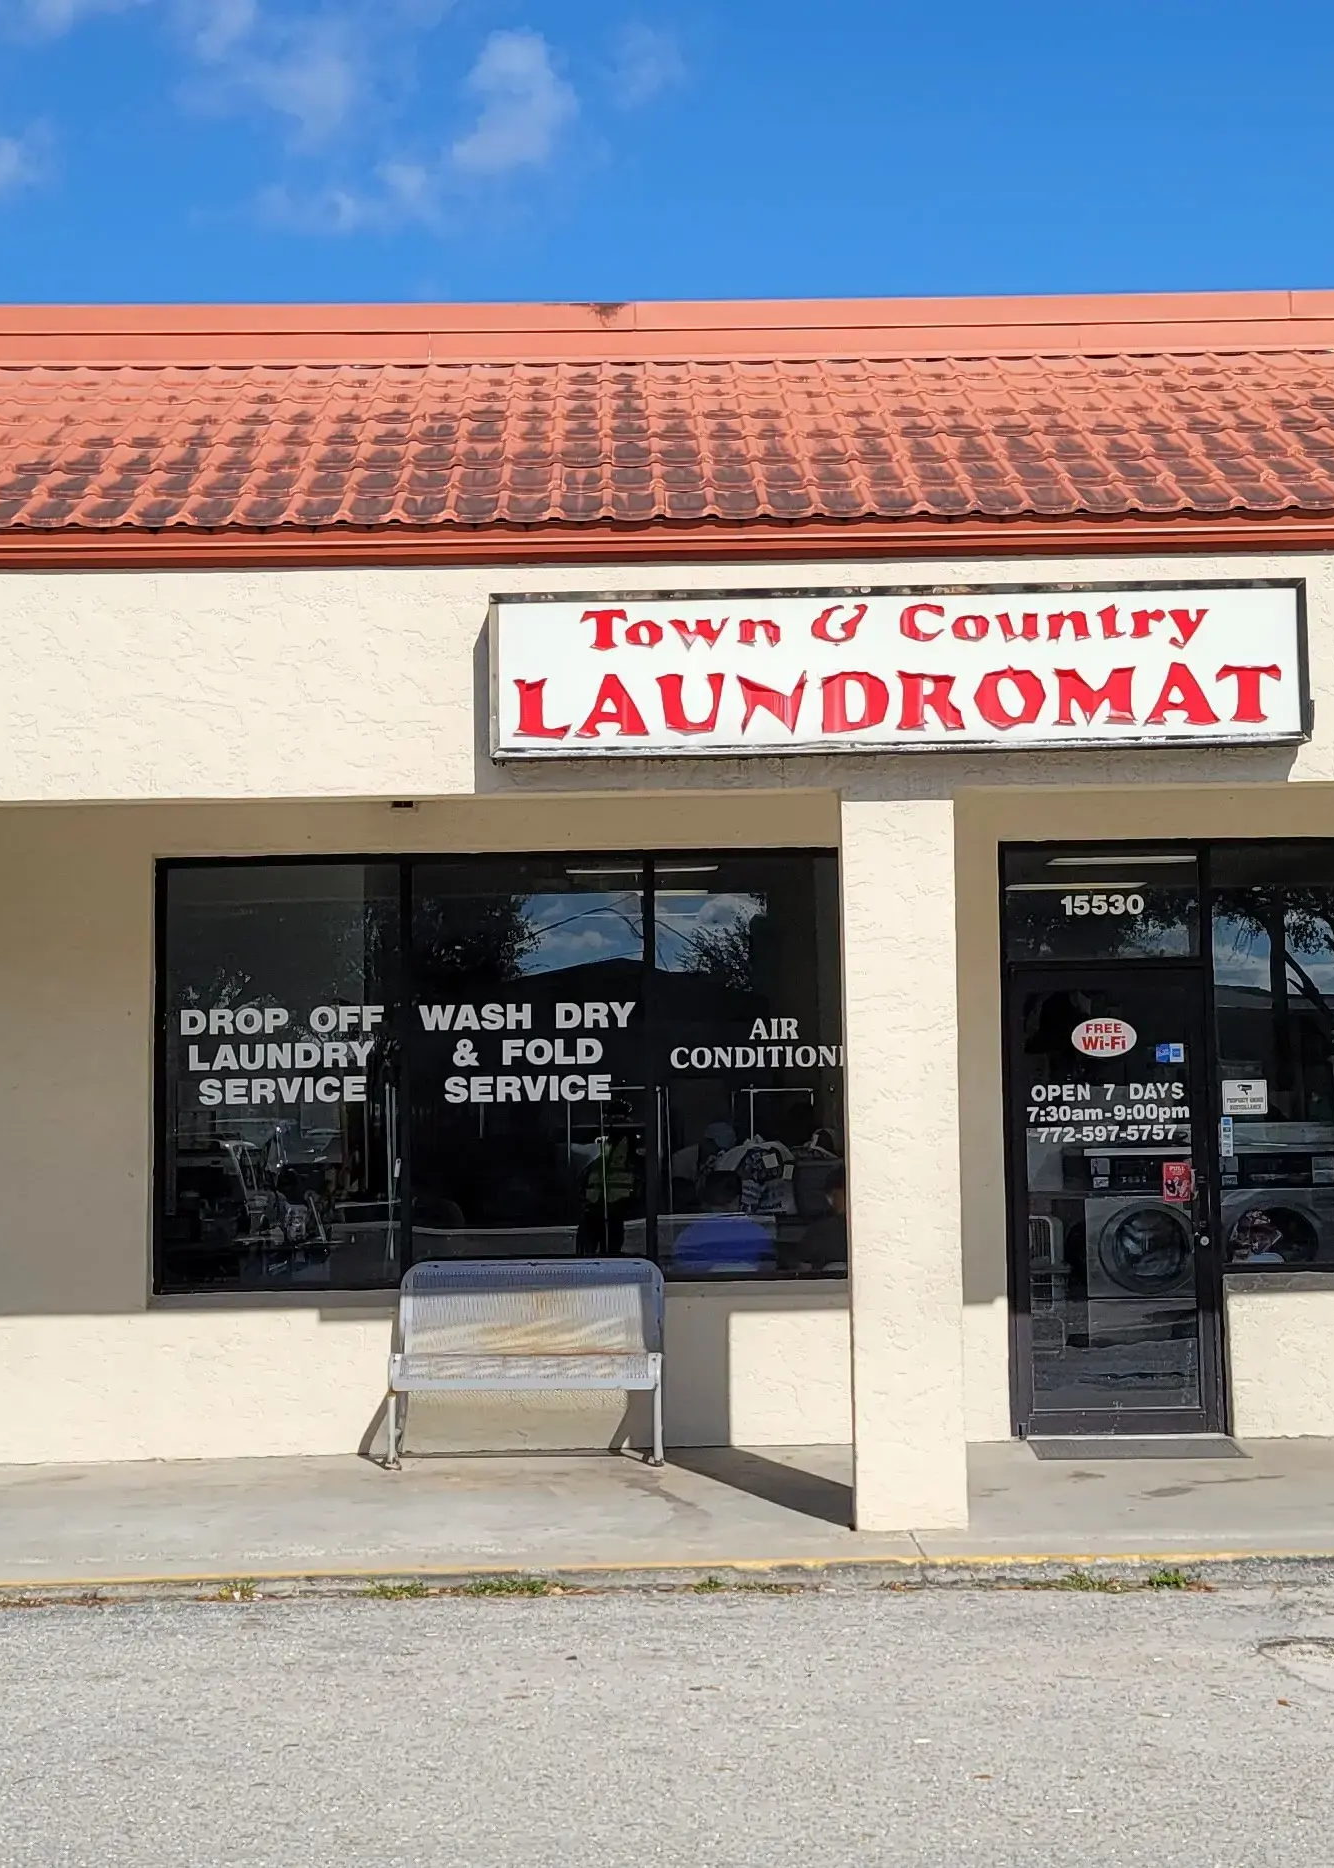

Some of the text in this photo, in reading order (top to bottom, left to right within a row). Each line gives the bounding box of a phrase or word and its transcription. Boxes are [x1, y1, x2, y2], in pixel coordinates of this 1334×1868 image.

[580, 602, 1209, 651] Town & Country
[512, 661, 1283, 739] LAUNDROMAT
[1060, 894, 1145, 916] 15530
[180, 1005, 385, 1036] DROP OFF
[418, 1001, 636, 1031] WASH DRY
[748, 1017, 799, 1040] AIR
[1085, 1023, 1123, 1034] FREE
[188, 1042, 375, 1071] LAUNDRY
[452, 1038, 604, 1067] & FOLD
[1082, 1036, 1127, 1051] Wi-Fi
[198, 1075, 367, 1106] SERVICE
[444, 1074, 612, 1103] SERVICE
[1030, 1081, 1185, 1102] OPEN 7 DAYS
[1026, 1104, 1190, 1123] 7:30am-9:00pm
[1037, 1124, 1177, 1144] 772-597-5757
